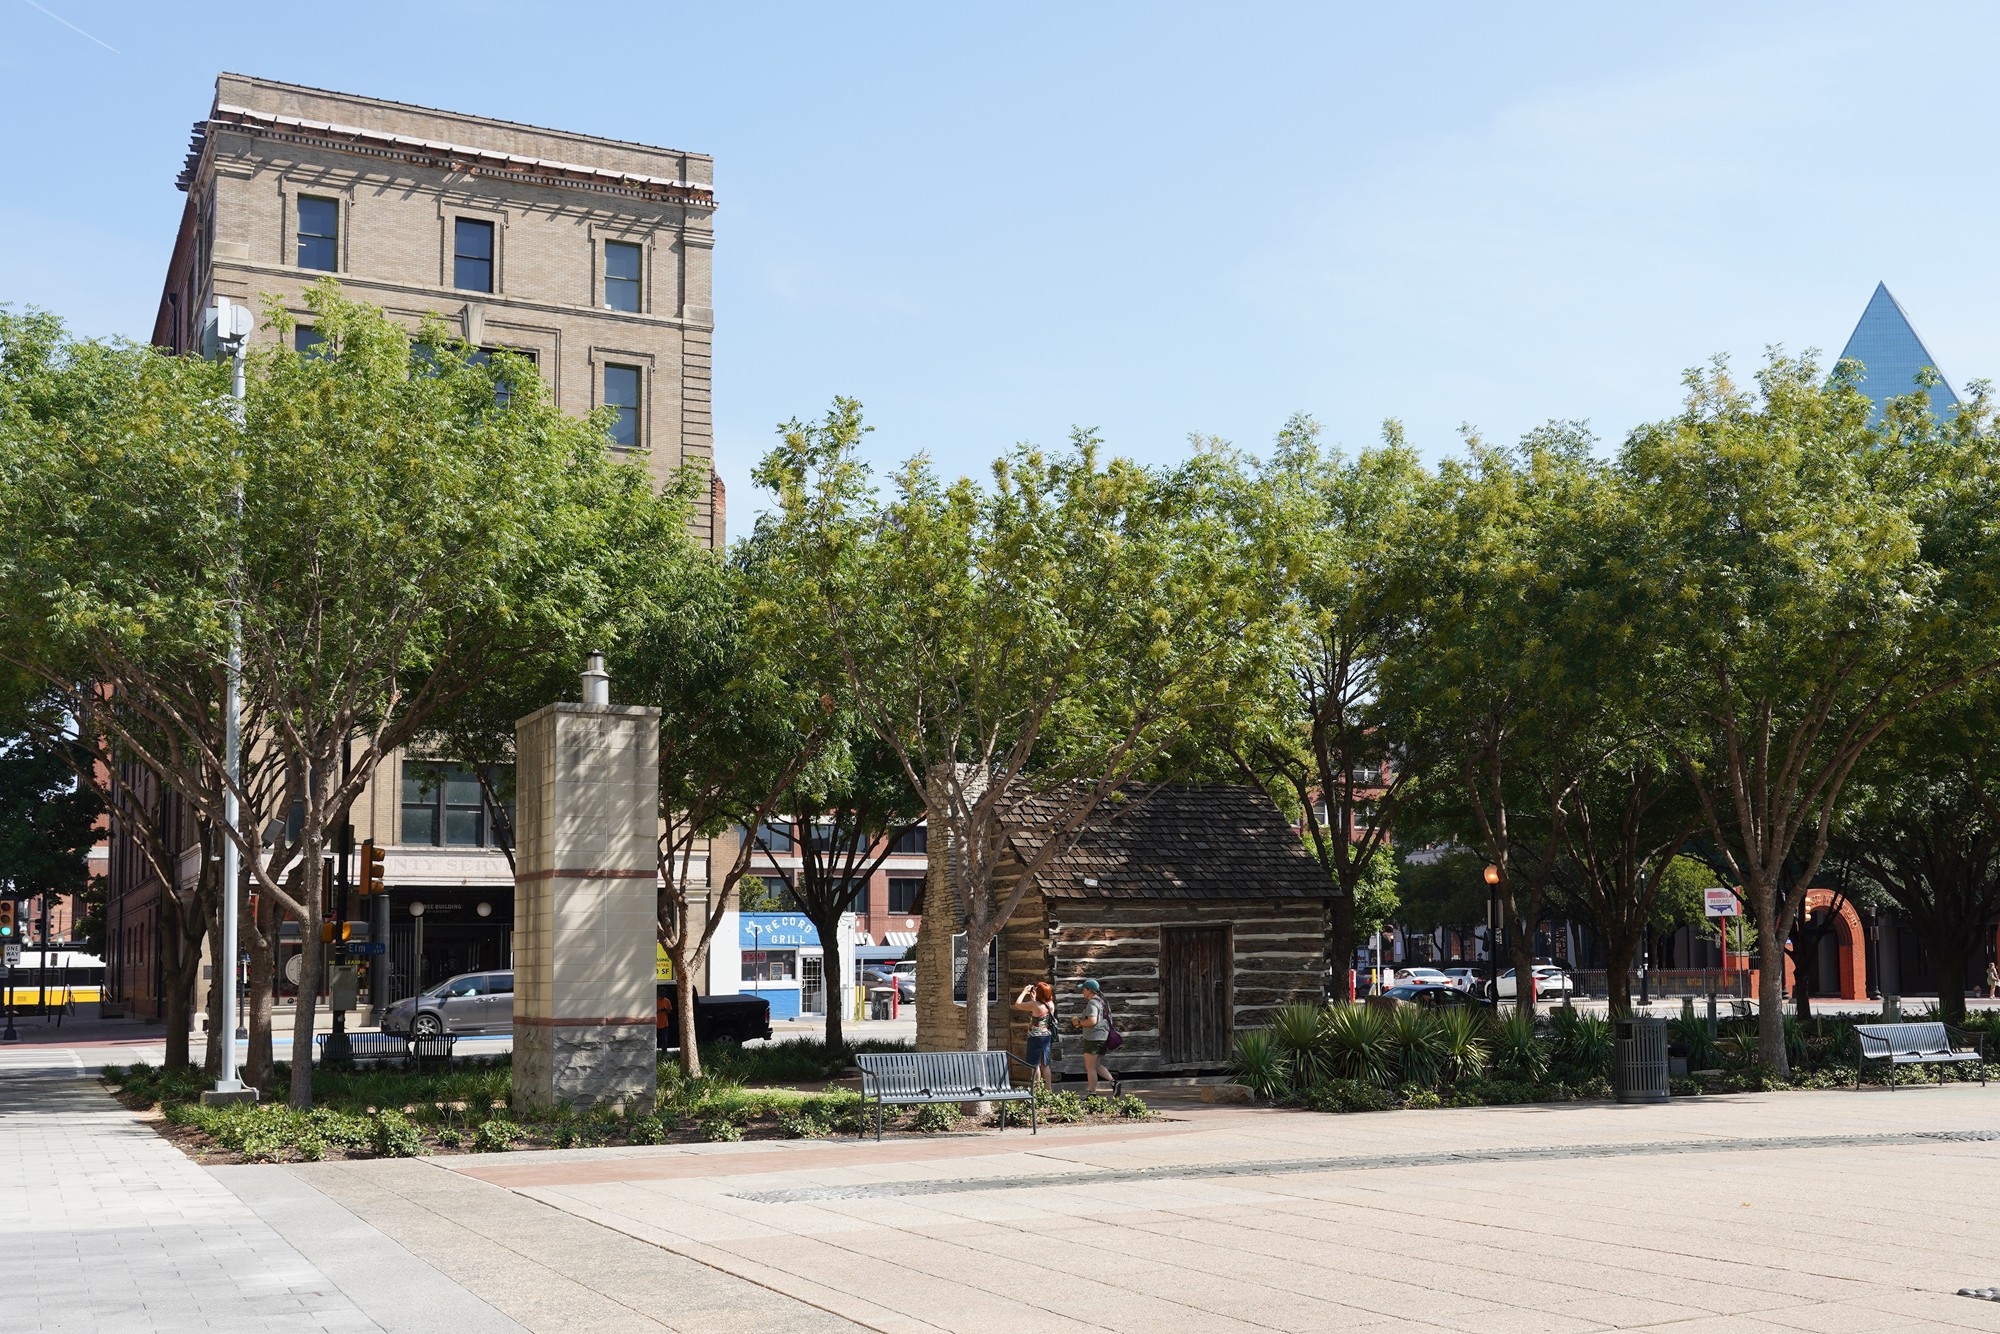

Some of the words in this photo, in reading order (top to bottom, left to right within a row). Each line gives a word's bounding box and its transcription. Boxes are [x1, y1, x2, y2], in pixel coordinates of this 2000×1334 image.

[764, 917, 813, 934] RECORD
[771, 935, 806, 944] GRILL
[348, 943, 366, 953] Elm
